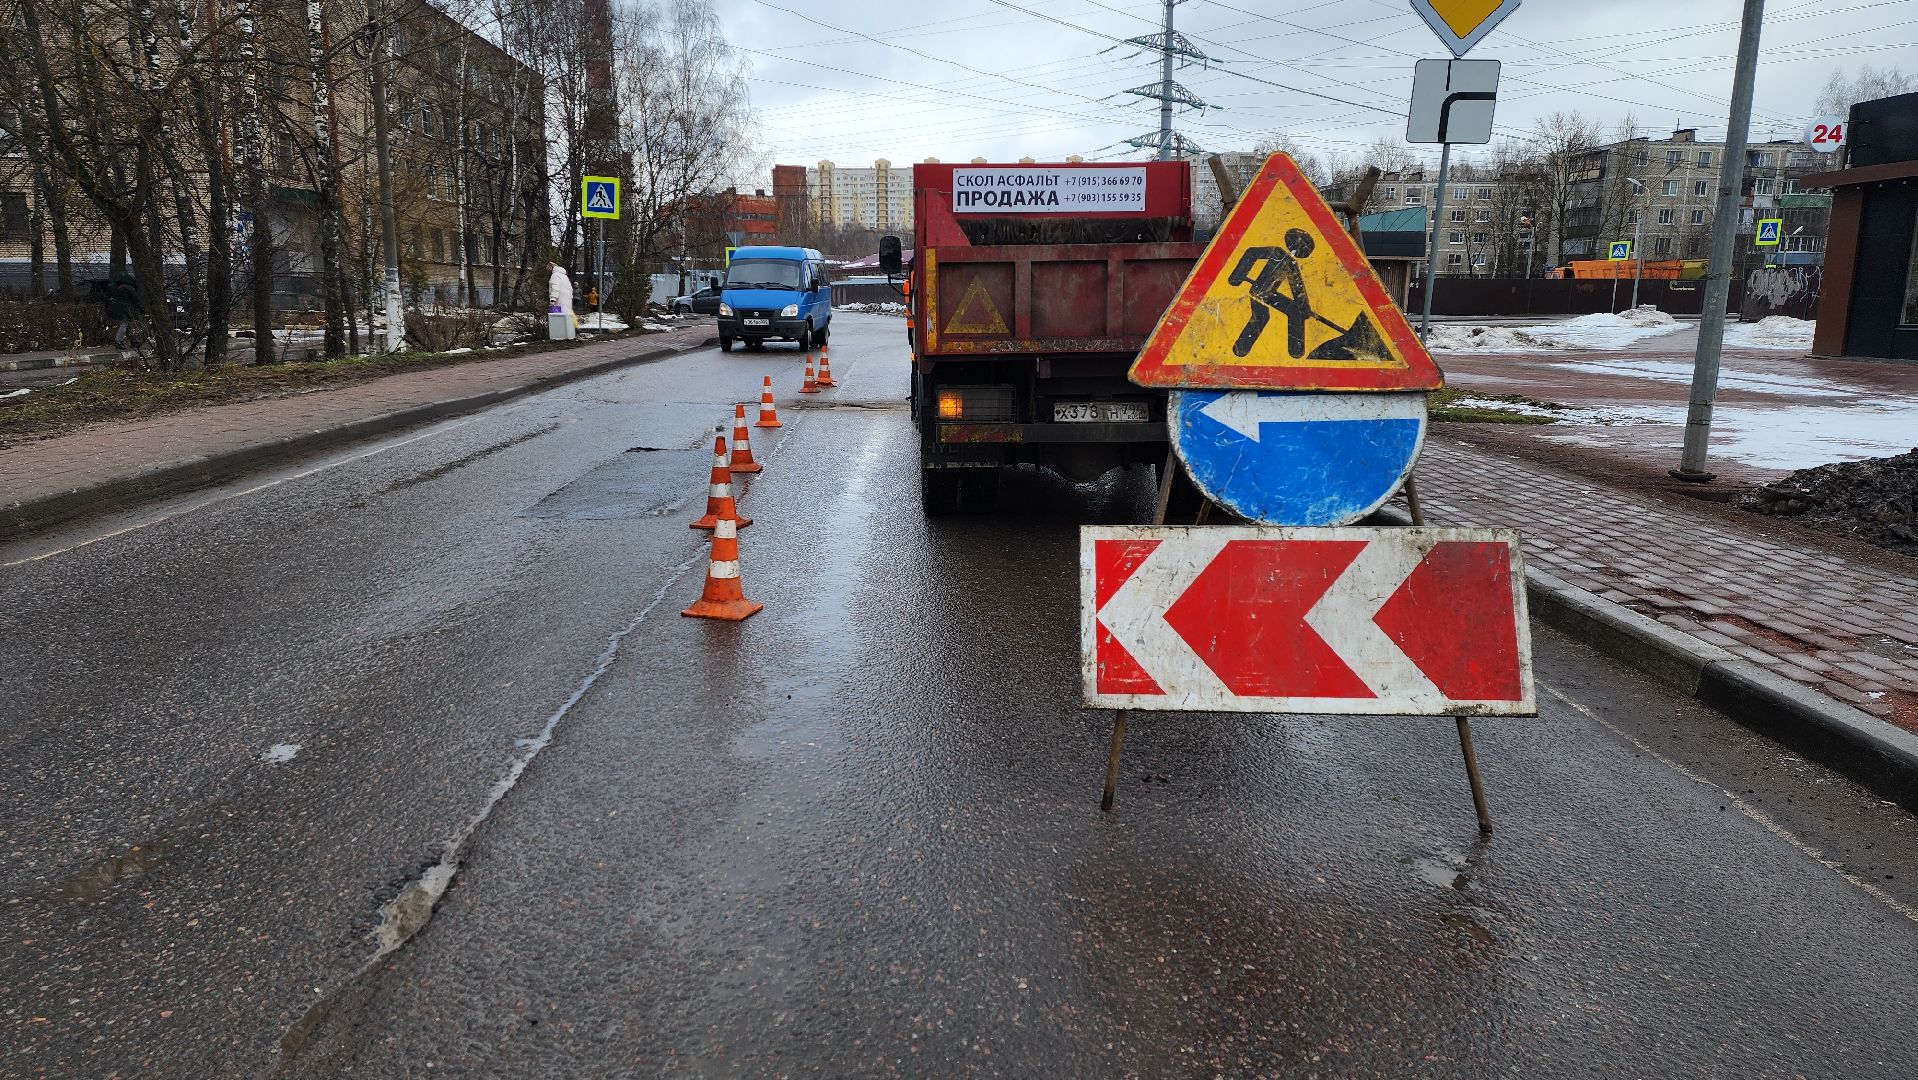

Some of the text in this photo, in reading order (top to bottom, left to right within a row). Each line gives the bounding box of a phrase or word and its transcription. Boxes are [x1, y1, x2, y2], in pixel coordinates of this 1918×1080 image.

[1812, 124, 1842, 143] 24
[957, 174, 1060, 187] СКОЛ АСФАЛЬТ
[1064, 175, 1143, 187] +7 (915) 366 69 70
[957, 190, 1060, 207] ПРОДАЖА
[1064, 192, 1142, 203] +7 (903) 155 59 35
